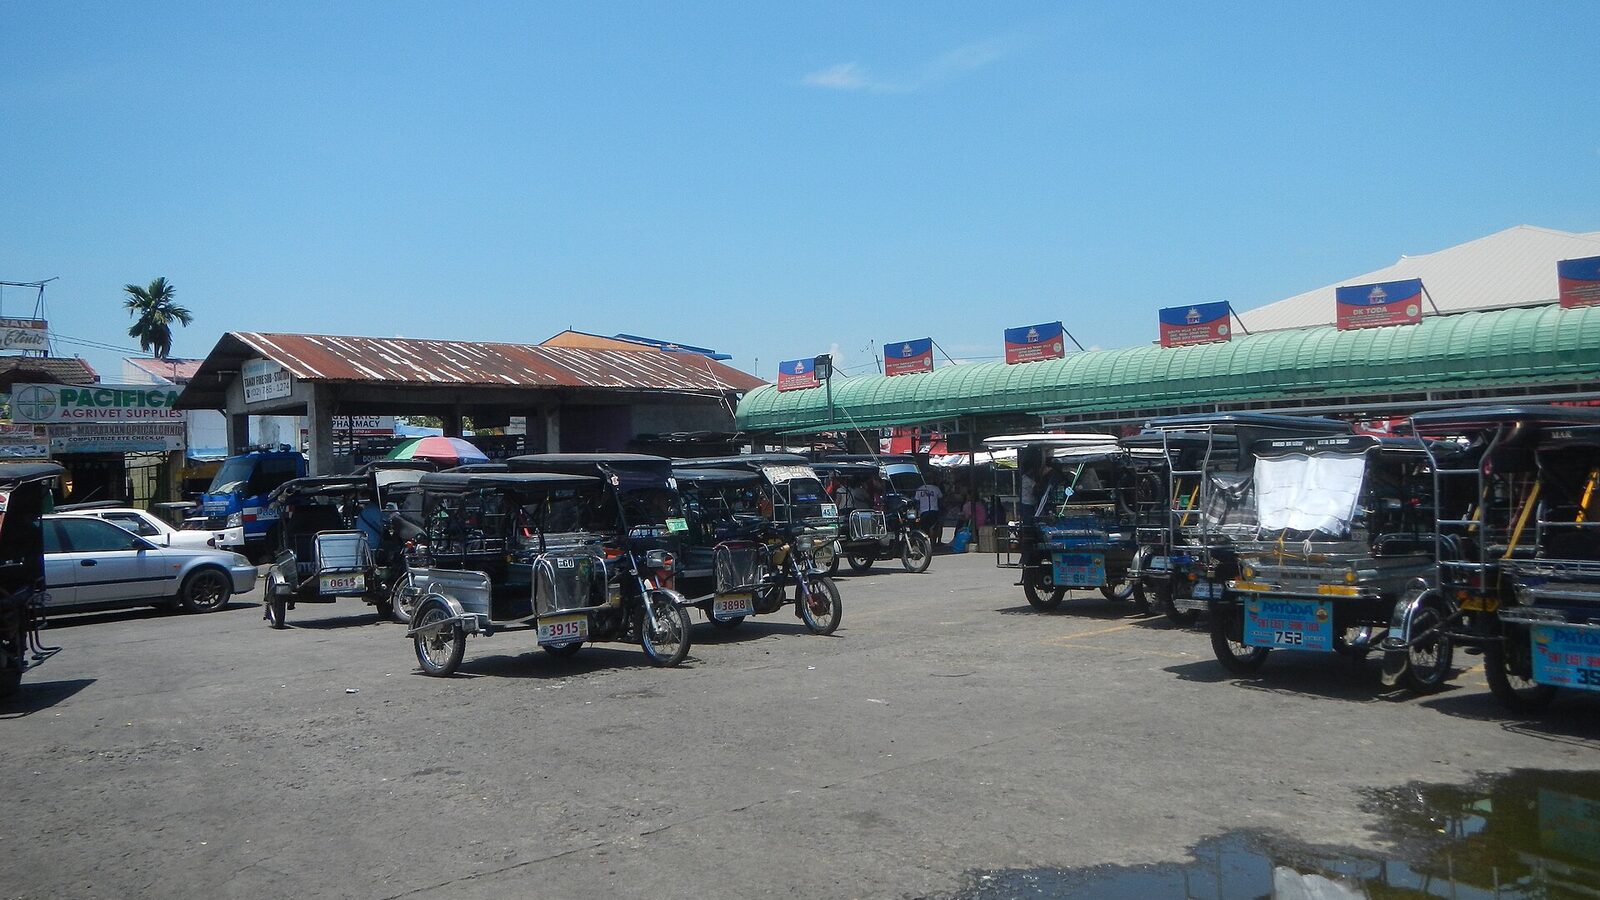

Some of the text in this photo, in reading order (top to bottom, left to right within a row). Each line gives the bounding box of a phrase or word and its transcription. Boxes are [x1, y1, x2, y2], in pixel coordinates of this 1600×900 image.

[4, 329, 45, 346] Clinic
[61, 409, 183, 418] AGRIVET SUPPLIES
[722, 599, 746, 611] 3898
[1275, 631, 1302, 645] 752
